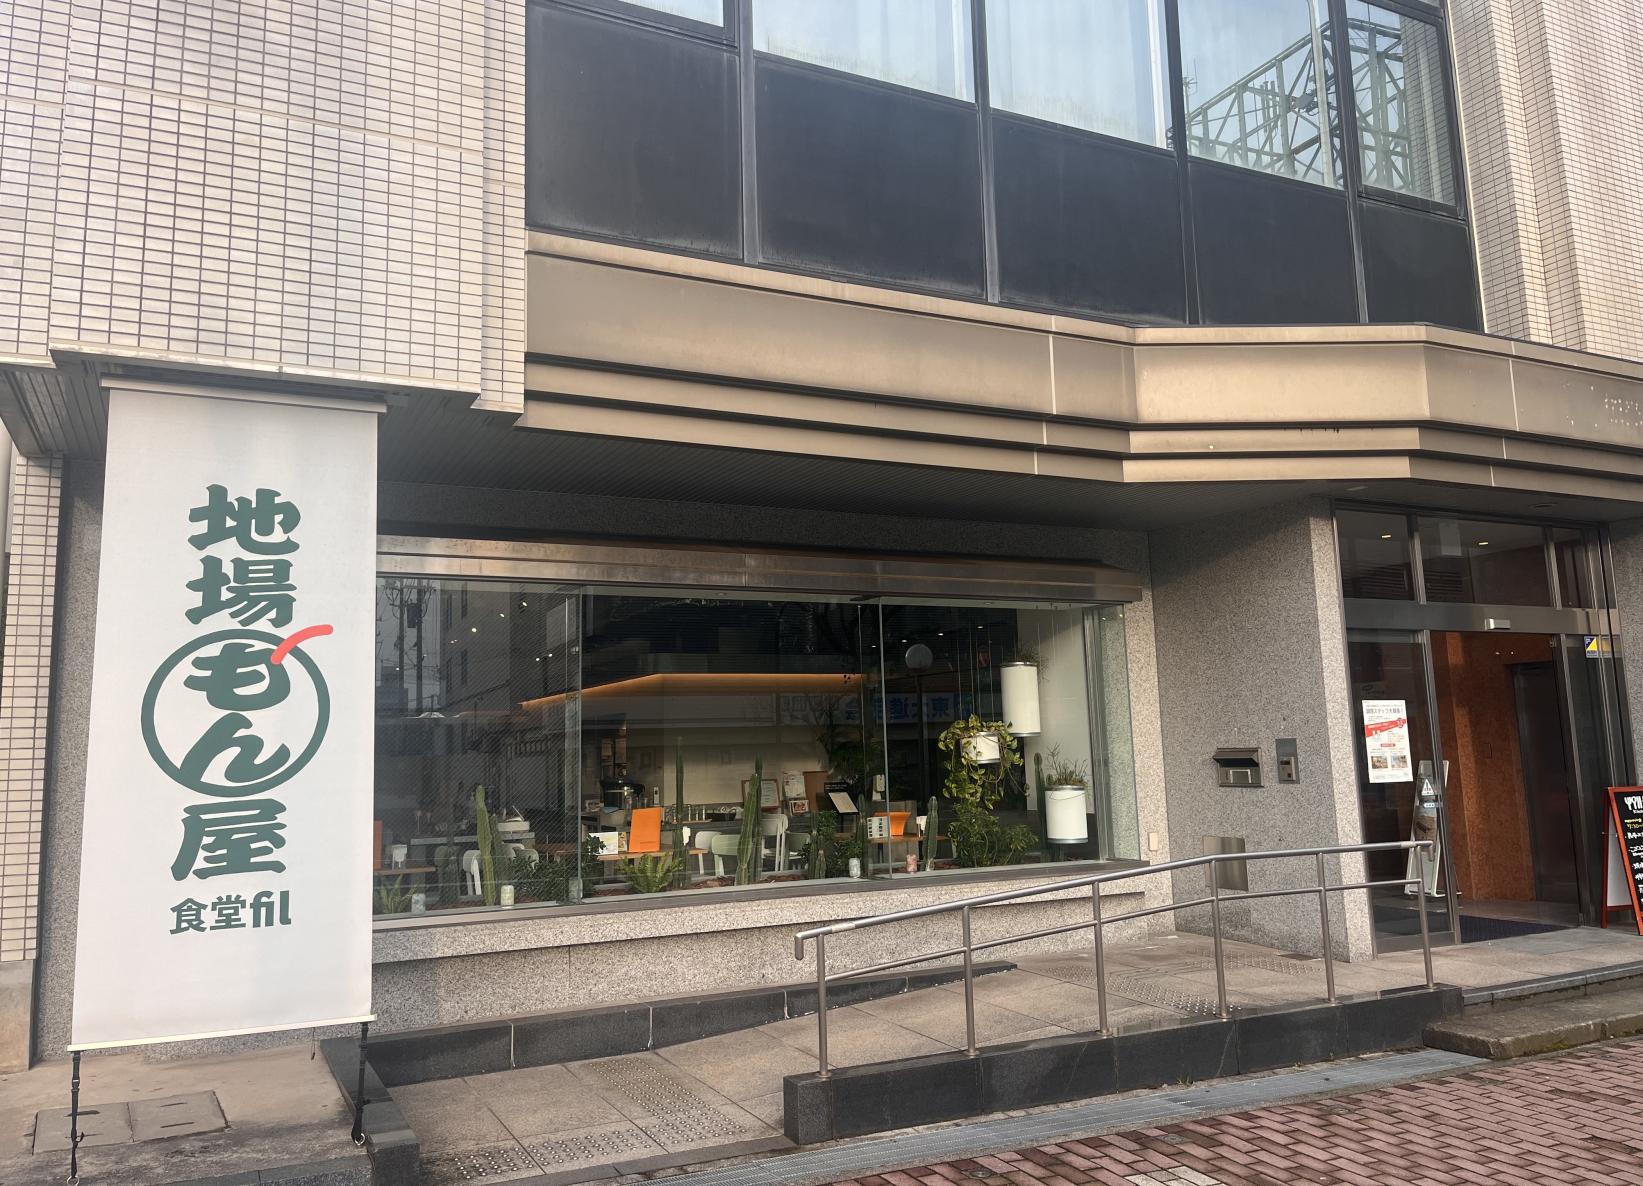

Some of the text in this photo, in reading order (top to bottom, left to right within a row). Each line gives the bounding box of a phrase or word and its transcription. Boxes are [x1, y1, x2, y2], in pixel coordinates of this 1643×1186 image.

[169, 483, 301, 882] 地場もん屋
